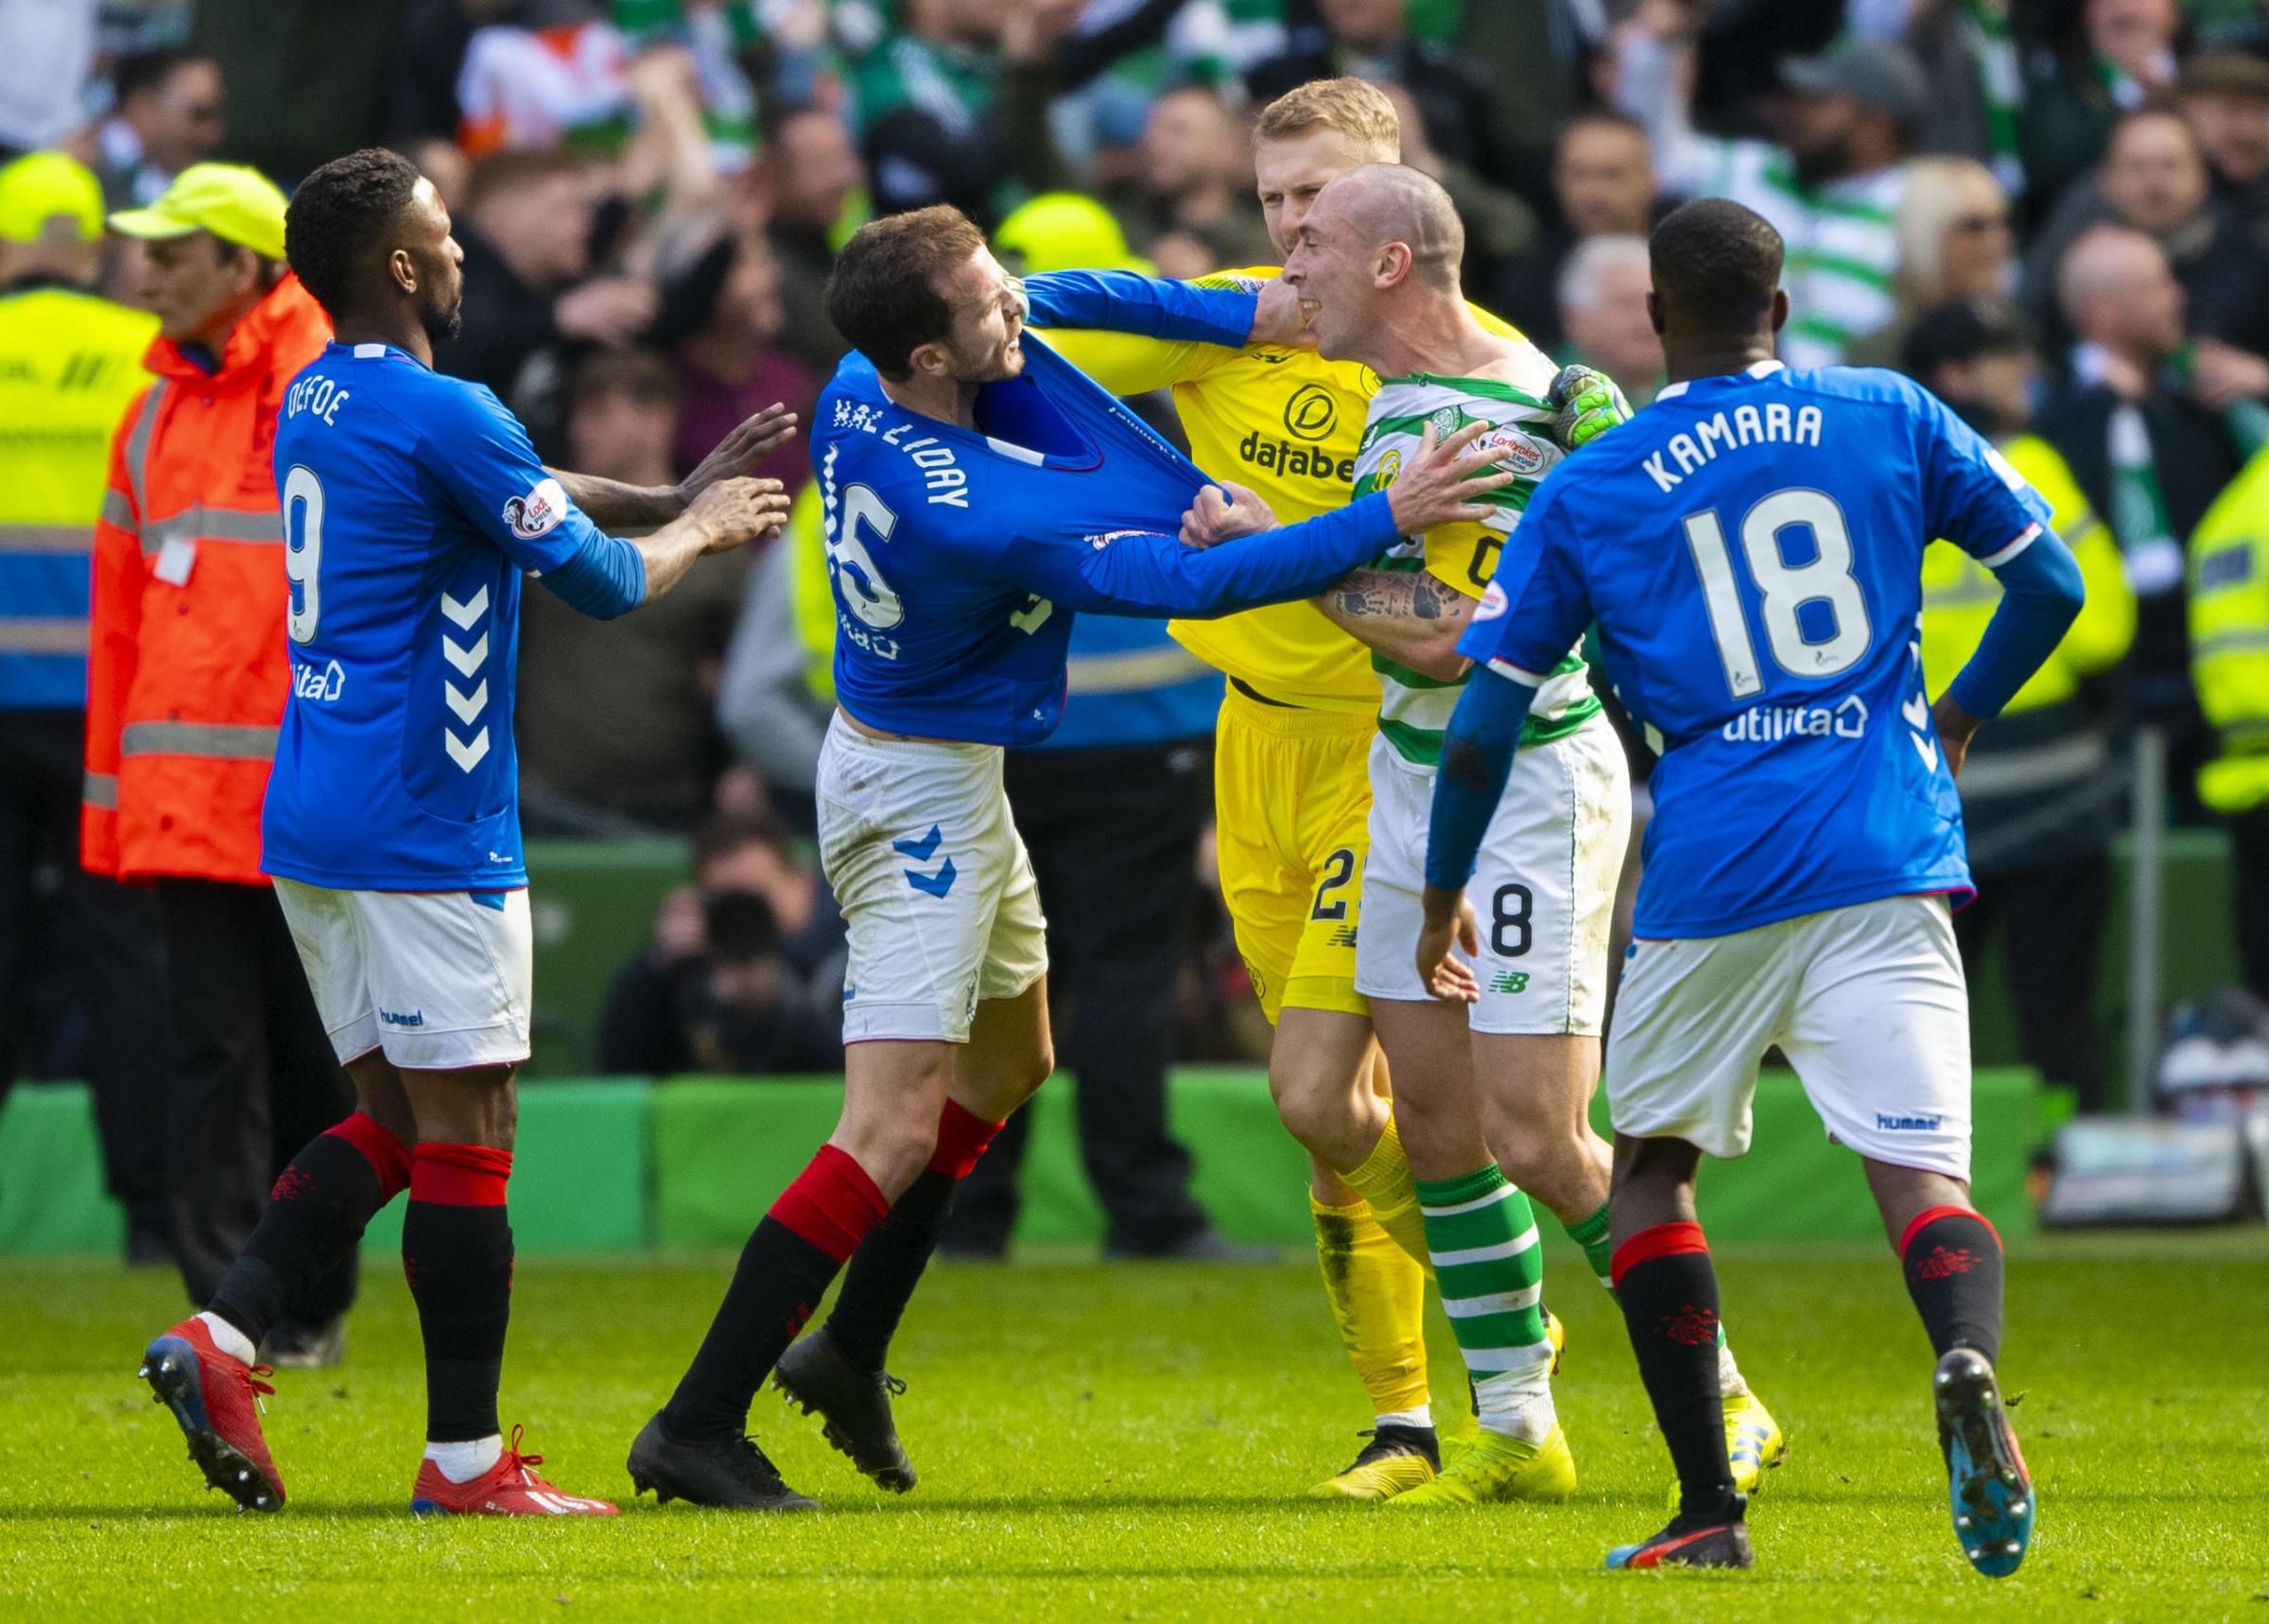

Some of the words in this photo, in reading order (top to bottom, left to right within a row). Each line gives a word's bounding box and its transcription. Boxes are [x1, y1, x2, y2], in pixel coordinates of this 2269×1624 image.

[288, 375, 350, 426] DEFOE
[1240, 431, 1355, 483] dafabe
[1642, 404, 1823, 492] KAMARA
[284, 463, 325, 646] 9
[1682, 487, 1873, 700] 18
[1723, 706, 1832, 742] utilita
[1310, 847, 1368, 922] 2
[1491, 883, 1533, 959] 8
